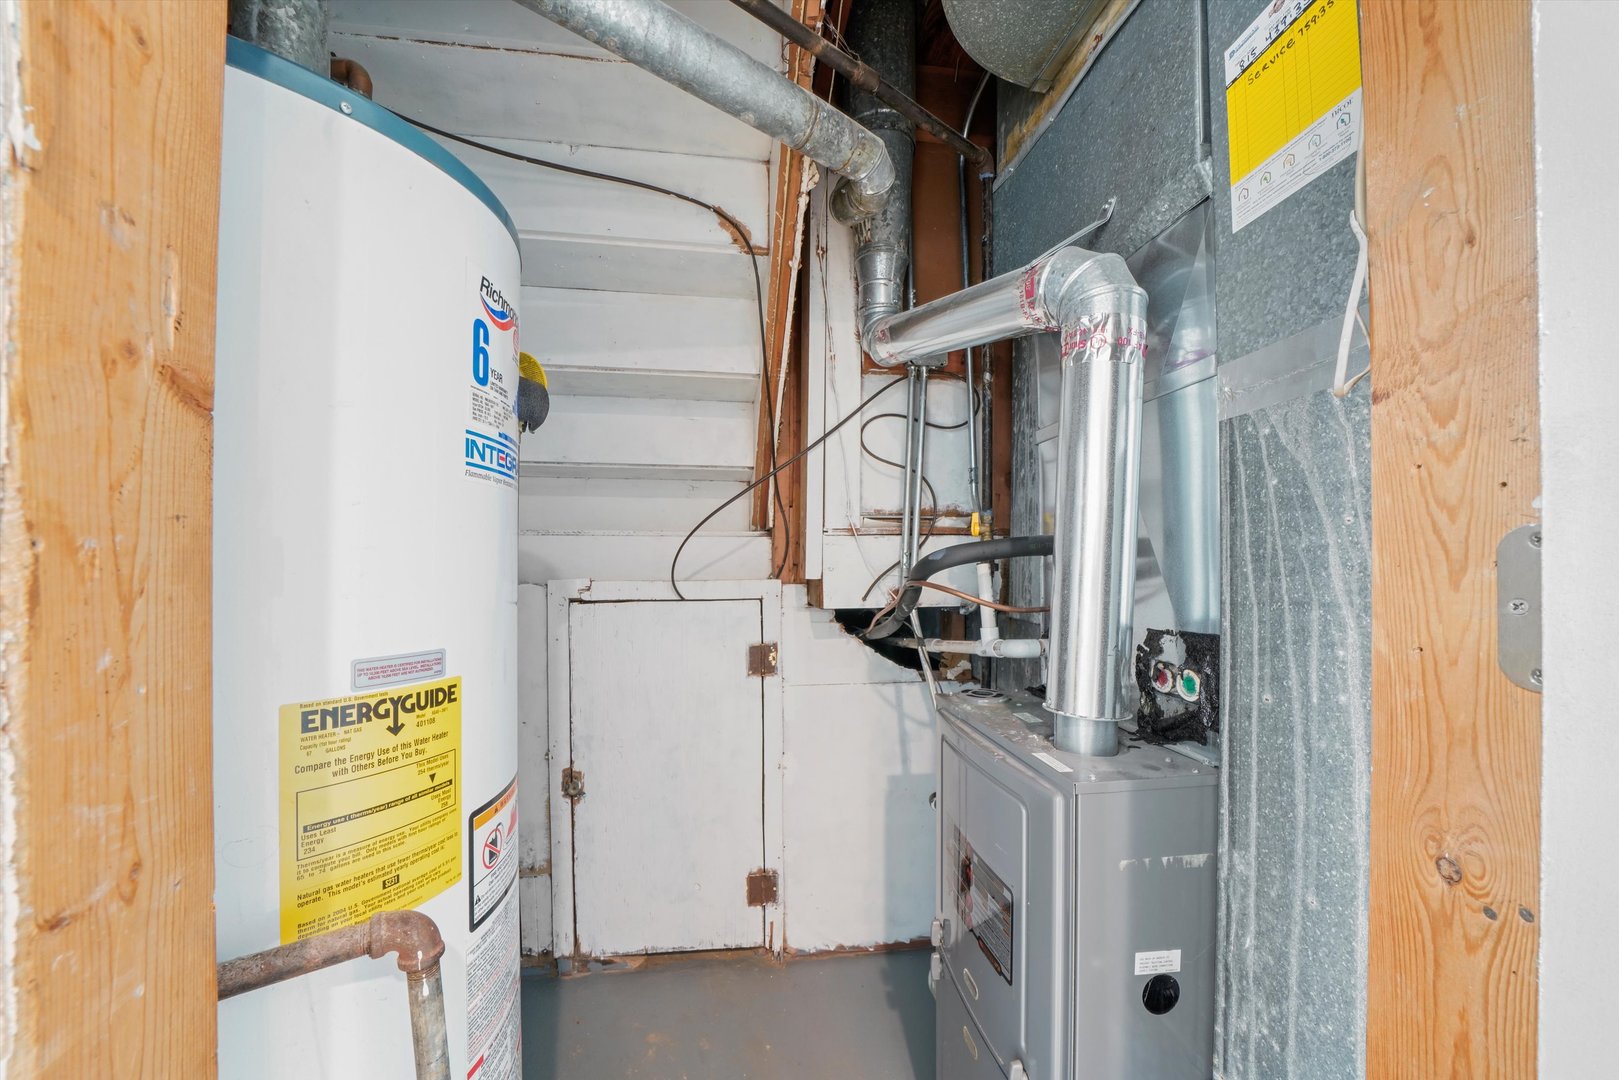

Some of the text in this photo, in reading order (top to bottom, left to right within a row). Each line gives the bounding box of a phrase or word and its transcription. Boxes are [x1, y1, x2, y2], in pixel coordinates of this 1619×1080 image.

[1239, 46, 1257, 70] 815
[472, 318, 488, 386] 6
[490, 368, 503, 384] YEAR
[301, 684, 457, 736] ENERGYGUIDE
[294, 731, 448, 774] Compare the Energy Use of this Water Heater
[325, 745, 346, 753] GALLONS
[332, 768, 348, 777] with
[351, 762, 374, 773] Others
[377, 755, 399, 766] Before
[415, 748, 427, 756] Buy.
[301, 827, 336, 840] Uses Least
[307, 821, 331, 831] Energy
[301, 837, 324, 847] Energy
[297, 856, 334, 869] Therms/year
[297, 896, 323, 908] operate.
[328, 889, 341, 898] This
[342, 880, 366, 893] model's
[367, 869, 392, 884] estimated
[394, 863, 408, 873] yearly
[410, 853, 430, 865] operating
[297, 889, 320, 900] Natural
[323, 886, 334, 894] gas
[336, 879, 352, 888] water
[354, 870, 374, 882] heaters
[376, 865, 385, 874] that
[297, 919, 316, 929] Based
[297, 925, 315, 934] therm
[297, 925, 329, 940] depending
